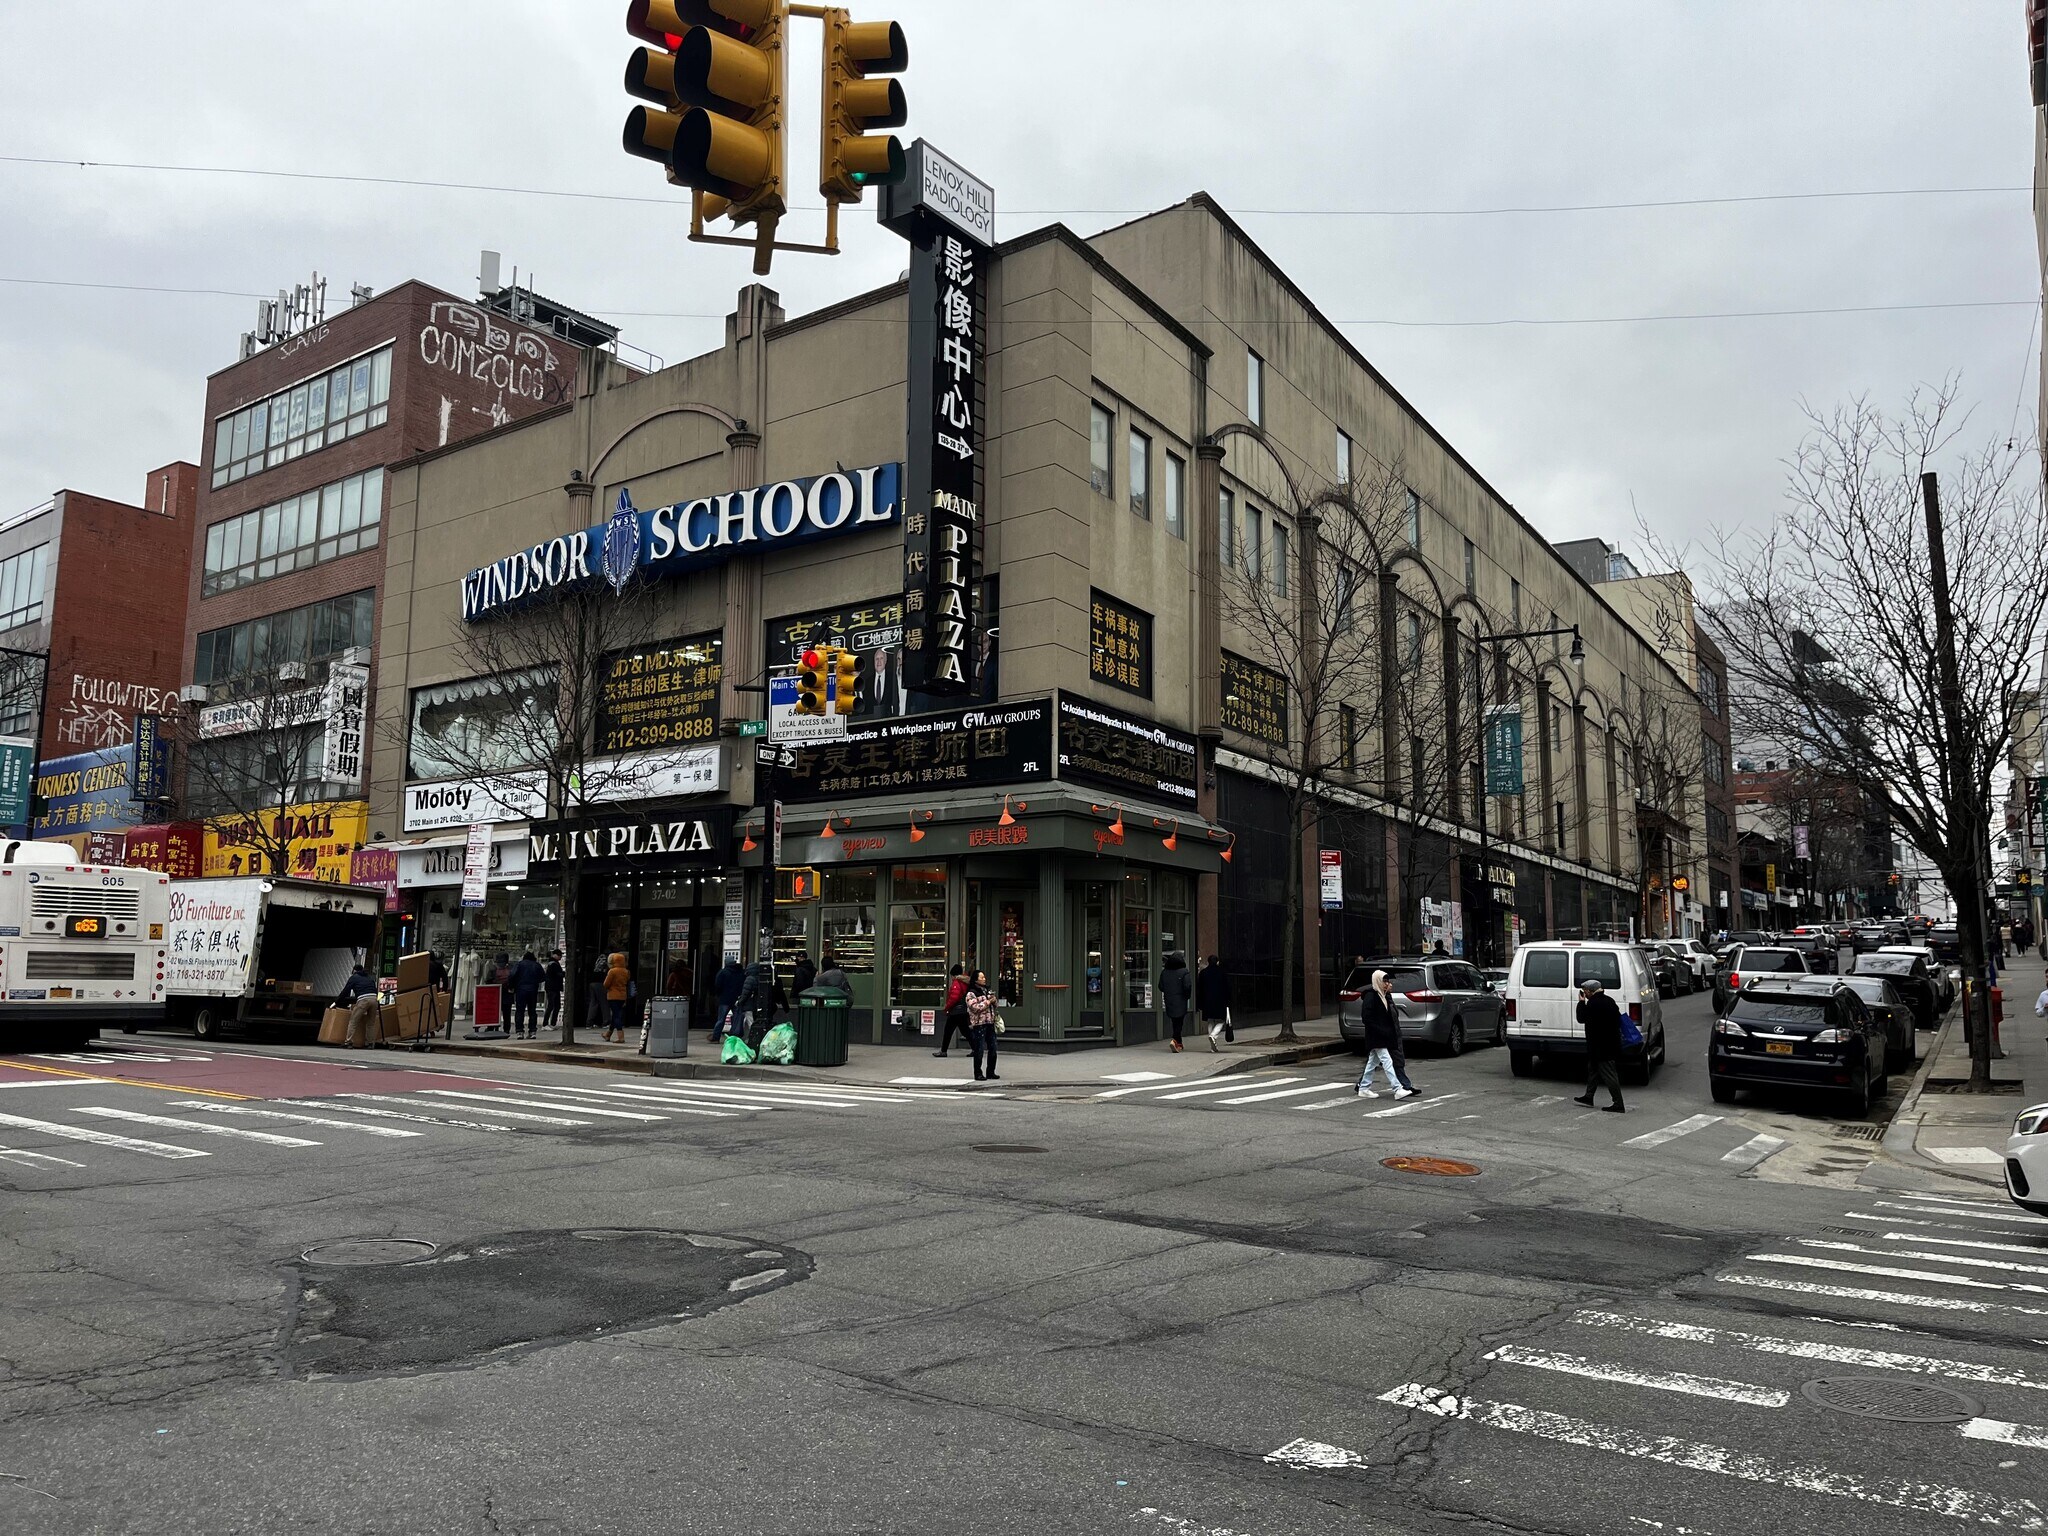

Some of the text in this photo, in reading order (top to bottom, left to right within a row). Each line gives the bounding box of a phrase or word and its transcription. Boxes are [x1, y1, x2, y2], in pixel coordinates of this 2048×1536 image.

[925, 154, 990, 213] LENOX HILL
[924, 177, 990, 234] RADIOLOGY
[942, 235, 974, 430] 影像中心
[934, 488, 976, 522] MAIN
[461, 466, 893, 619] WINDSOR SCHOOL
[905, 512, 927, 651] 時代商場
[940, 523, 968, 684] PLAZA
[1092, 602, 1140, 641] 车祸事故
[1092, 627, 1140, 664] 工地意外
[1092, 651, 1140, 688] 误诊误医
[772, 681, 788, 690] Main
[778, 717, 836, 728] LOCAL ACCESS ONLY
[983, 714, 1003, 726] LAW
[1004, 709, 1041, 722] GROUPS
[1061, 701, 1069, 711] Car
[1087, 709, 1102, 722] Medical
[607, 717, 713, 749] 212-899-8888
[743, 724, 757, 735] Main
[772, 727, 843, 739] EXCEPT TRUCKS & BUSES
[882, 728, 888, 736] &
[890, 723, 932, 735] Workplace
[933, 720, 957, 733] Injury
[1220, 706, 1284, 743] 212-899-8888
[762, 750, 775, 760] ONE
[790, 727, 1009, 779] 古灵王律师团
[1176, 740, 1195, 755] GROUPS
[1023, 761, 1039, 773] 2FL
[1059, 754, 1071, 766] 2FL
[37, 771, 81, 799] USINESS
[83, 761, 127, 793] CENTER
[673, 768, 714, 785] 第一保健
[415, 787, 473, 811] Moloty
[510, 791, 532, 803] Tailor
[273, 814, 334, 840] MALL
[409, 818, 420, 827] 3702
[422, 817, 433, 826] Main
[440, 816, 449, 824] 2FL
[608, 820, 711, 857] PLAZA
[841, 835, 887, 859] eyeview
[968, 826, 1029, 847] 視美眼鏡
[1093, 829, 1124, 852] eyeview
[131, 841, 159, 858] 尚富堂
[102, 877, 124, 887] 605
[656, 889, 677, 901] 37-02
[186, 899, 232, 921] Furniture
[174, 929, 241, 953] 發傢俱城
[176, 969, 225, 980] 718-321-8870
